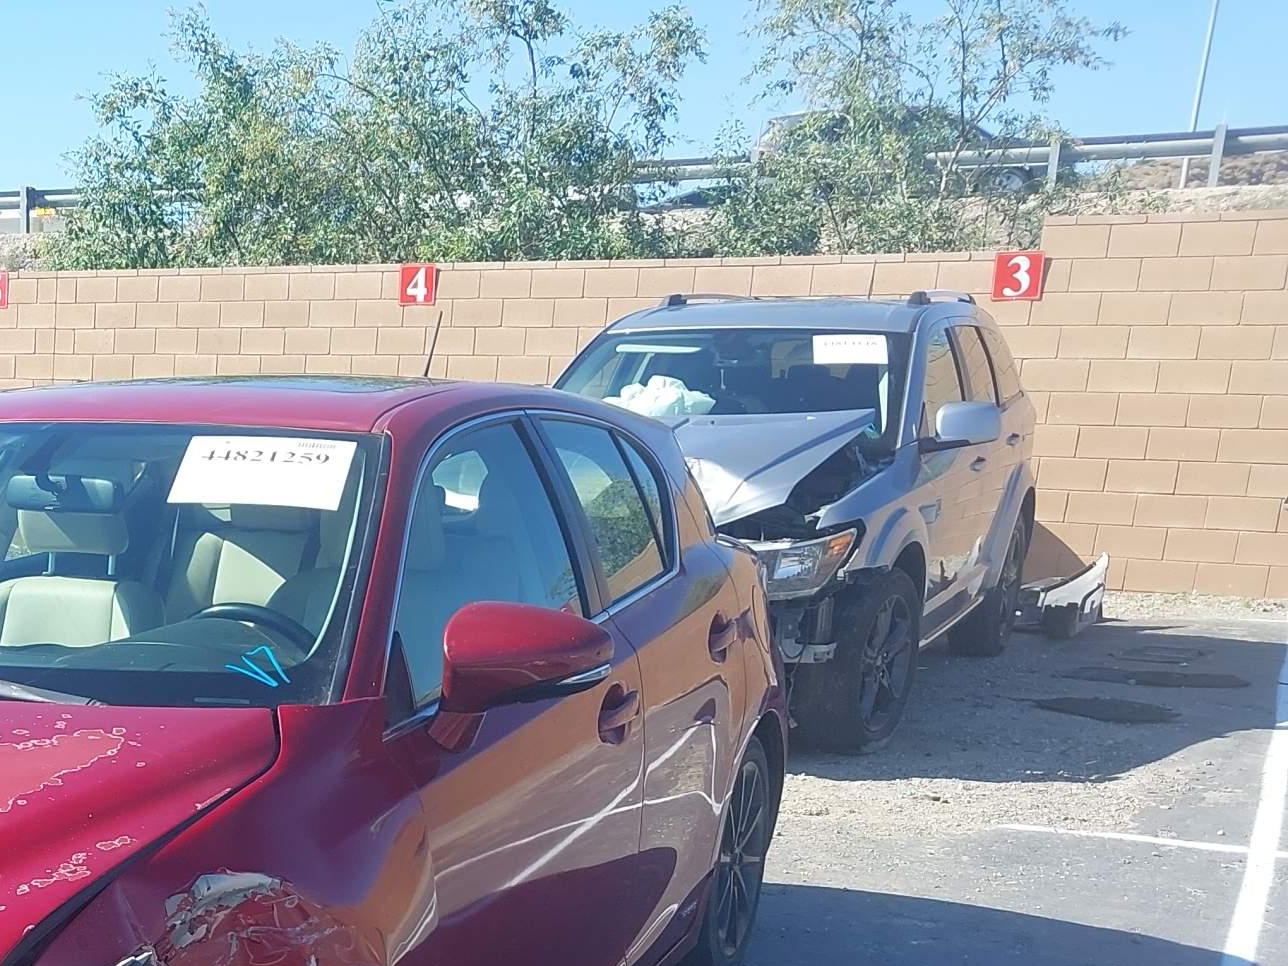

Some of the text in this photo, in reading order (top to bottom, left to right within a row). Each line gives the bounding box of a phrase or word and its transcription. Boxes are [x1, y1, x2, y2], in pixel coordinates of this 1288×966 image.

[406, 266, 428, 303] 4
[1001, 254, 1031, 297] 3
[201, 447, 331, 465] 44821259
